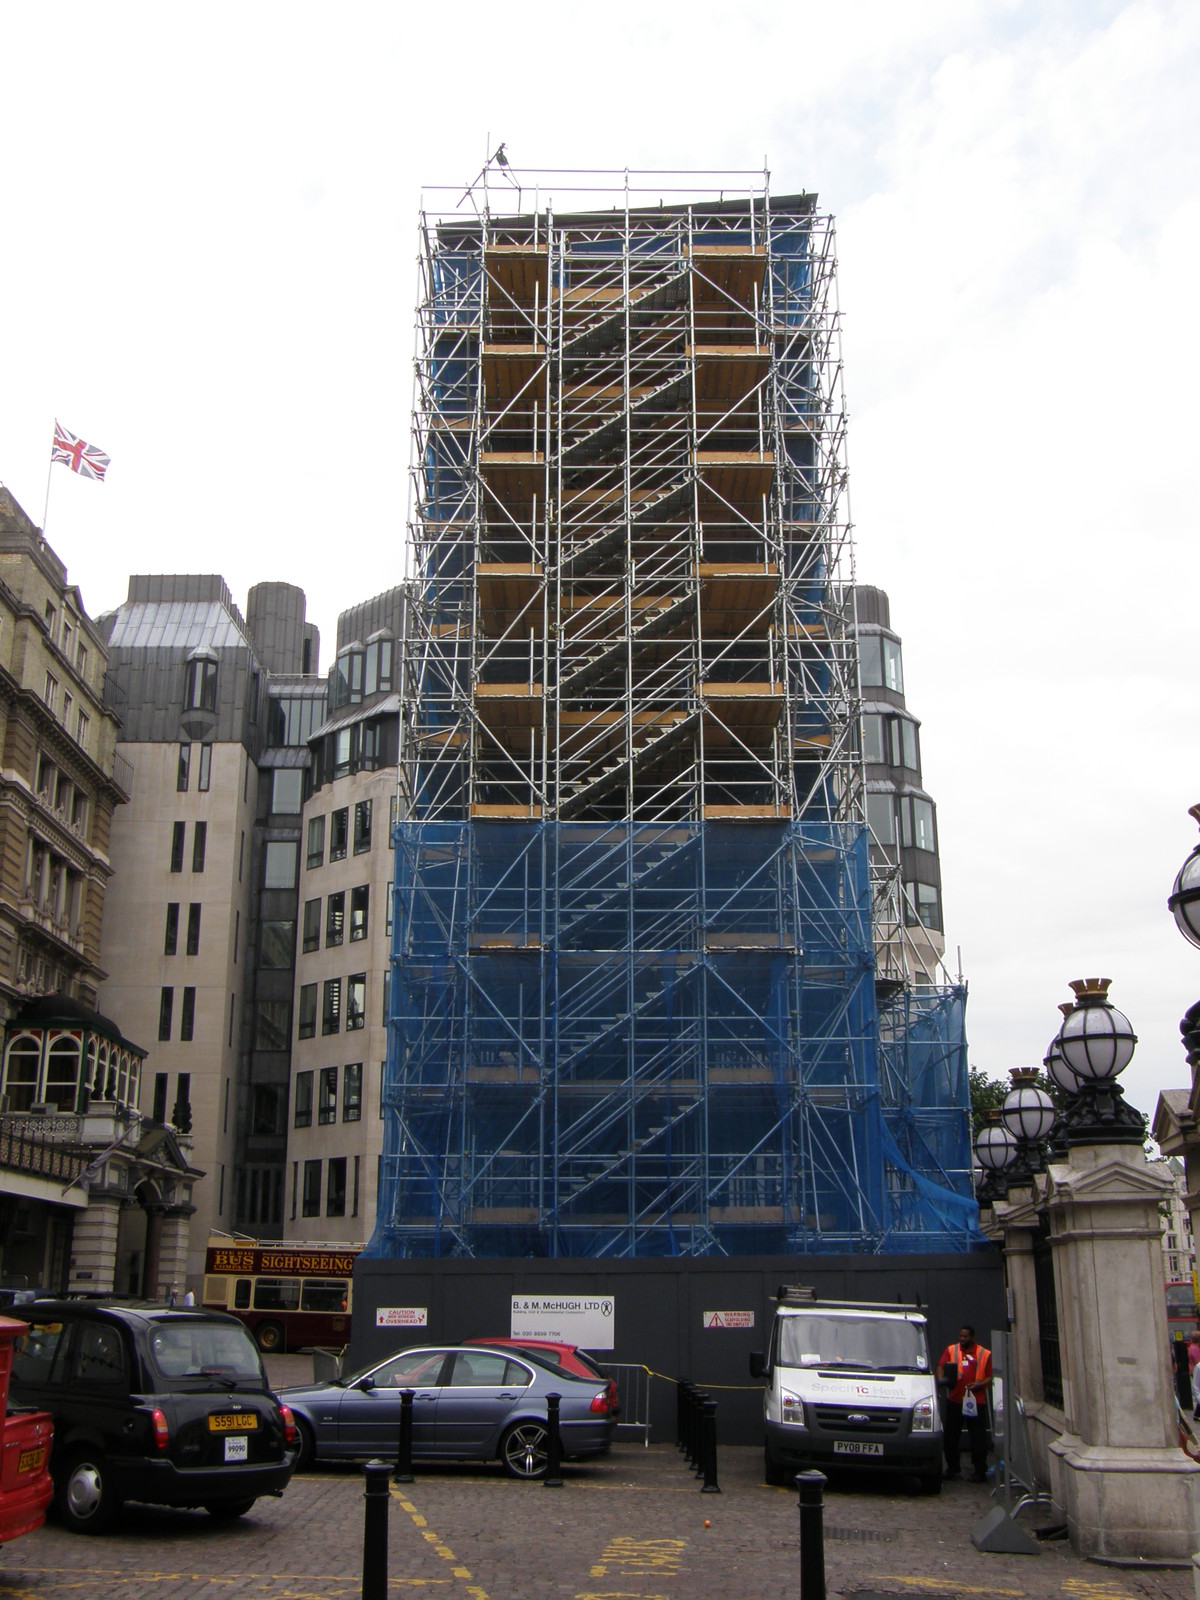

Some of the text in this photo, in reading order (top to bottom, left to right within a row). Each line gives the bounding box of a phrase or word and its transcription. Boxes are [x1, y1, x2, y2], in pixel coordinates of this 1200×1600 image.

[214, 1255, 254, 1265] BUS
[261, 1256, 353, 1269] SIGHTSEEING
[543, 1302, 580, 1310] McHUGH
[872, 1386, 905, 1397] Heat
[214, 1415, 253, 1427] S591 LGC
[837, 1442, 879, 1453] PY08 FFA
